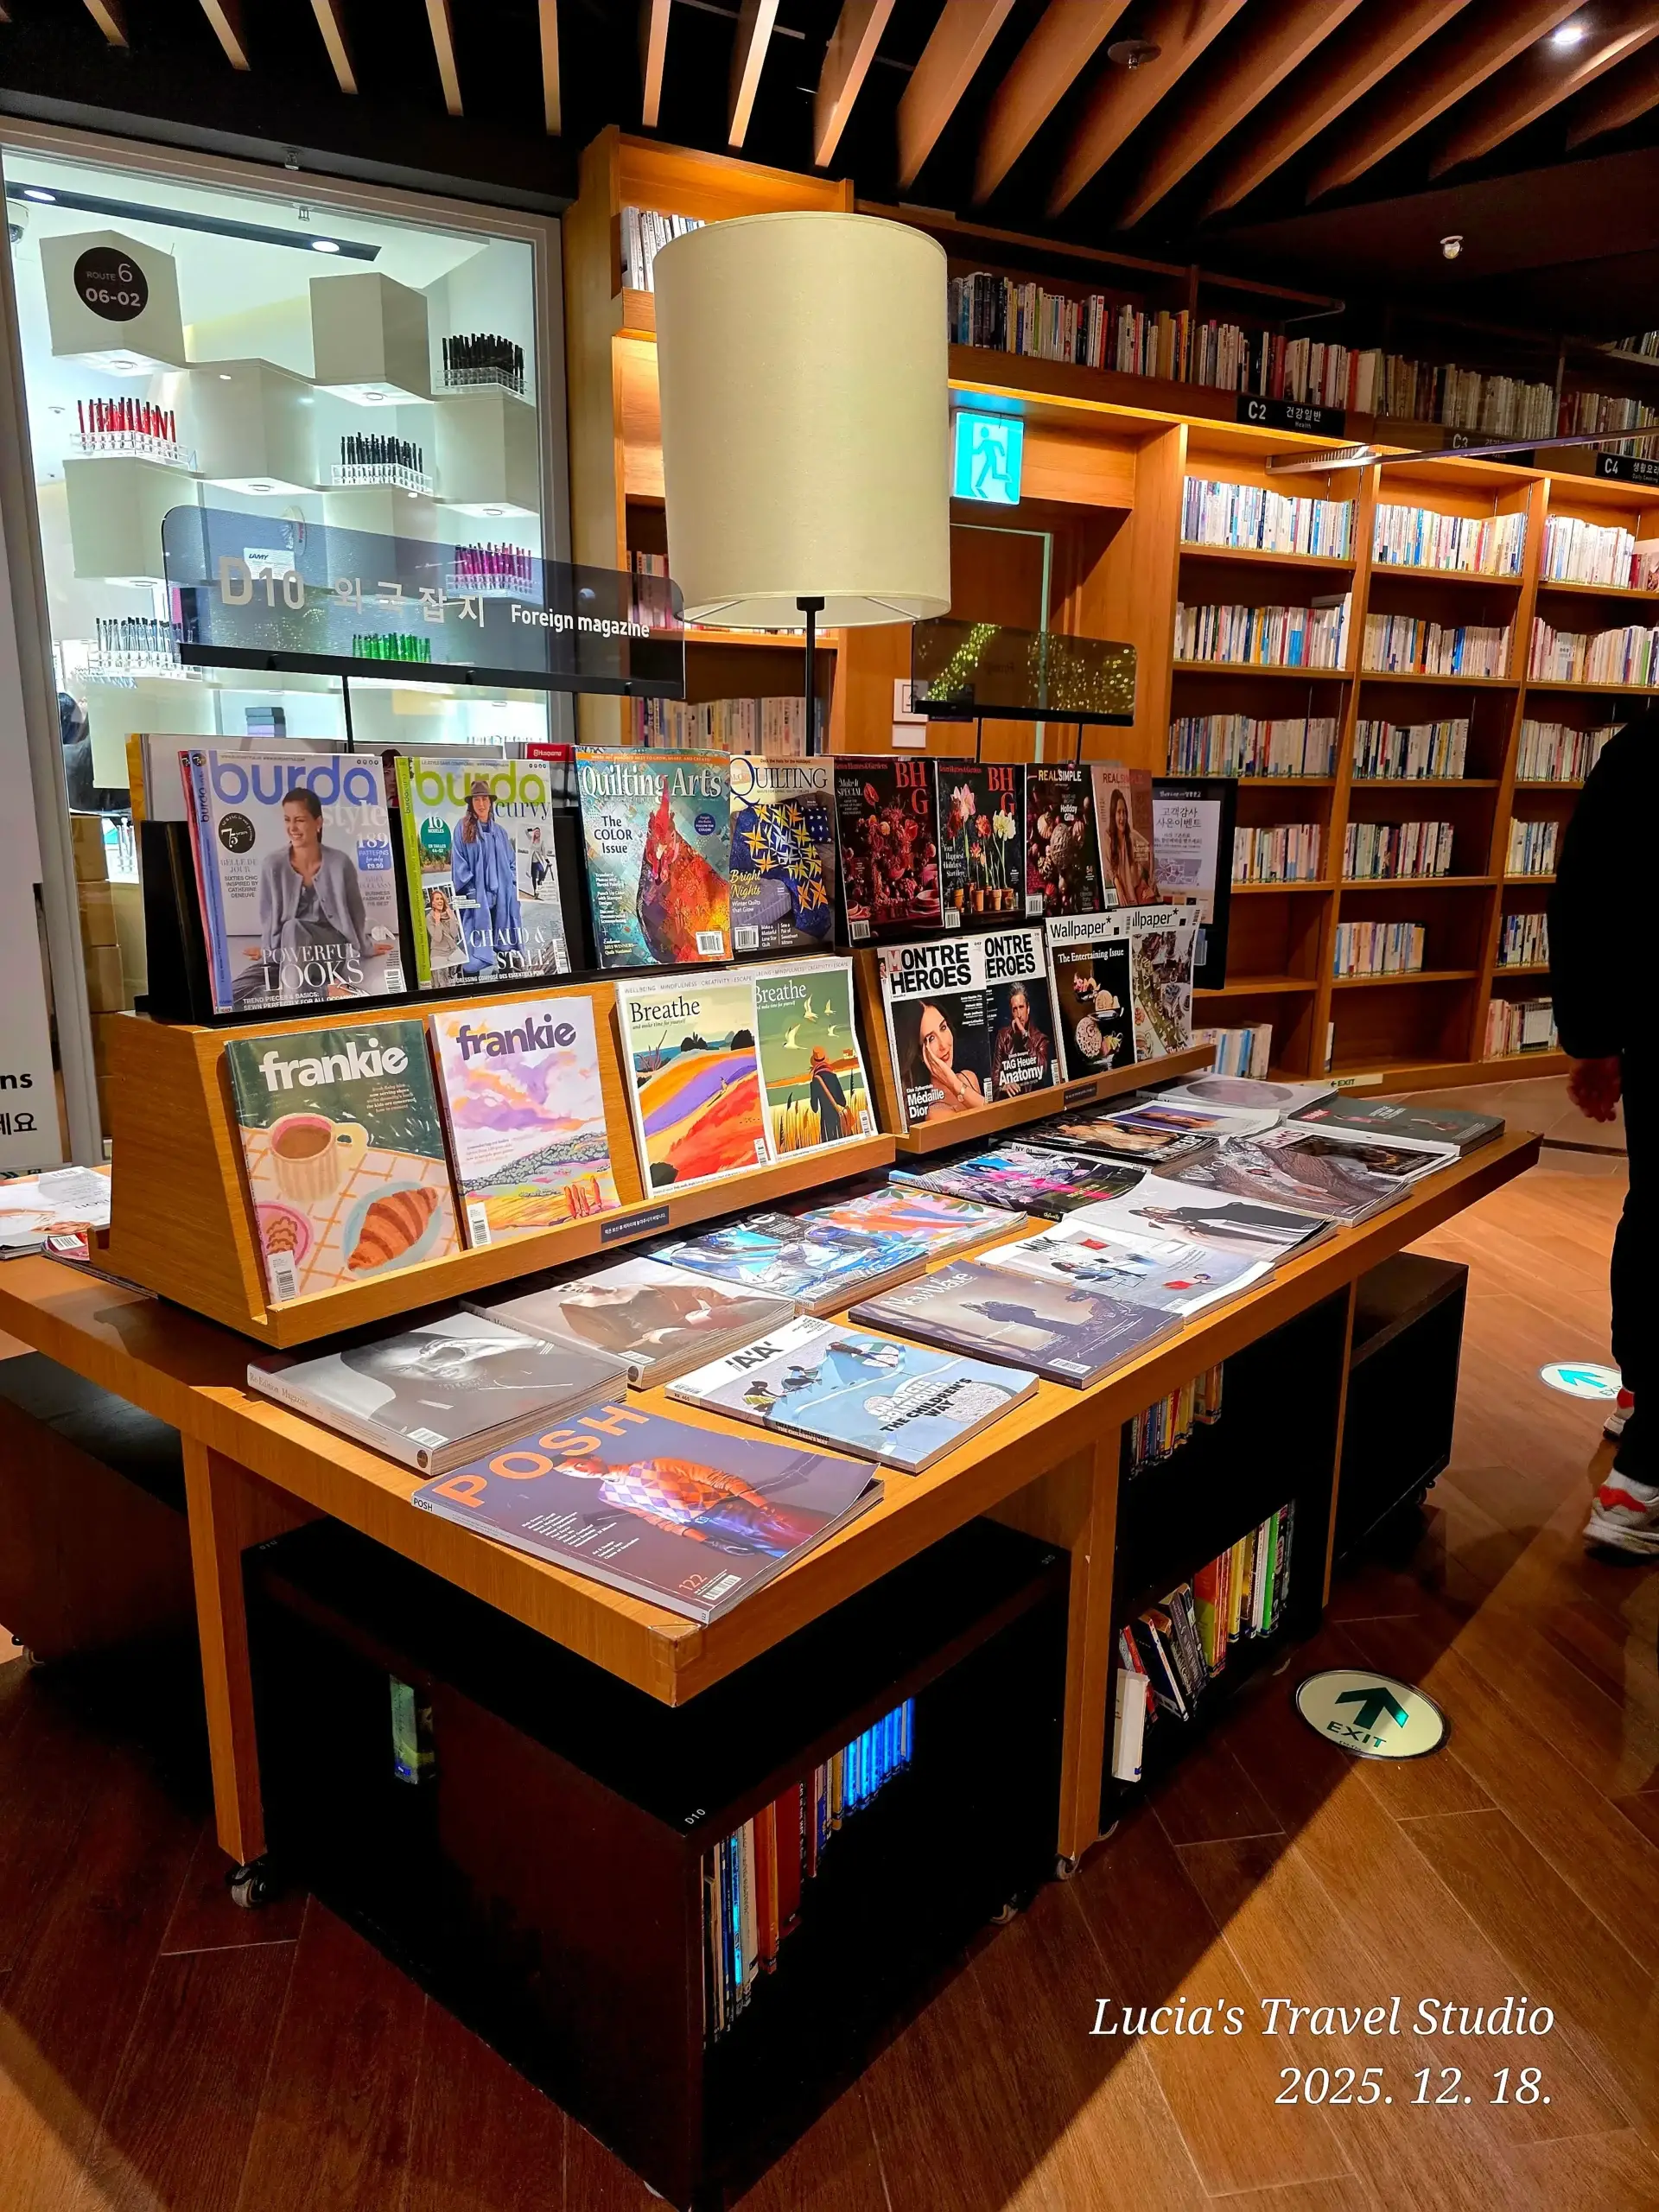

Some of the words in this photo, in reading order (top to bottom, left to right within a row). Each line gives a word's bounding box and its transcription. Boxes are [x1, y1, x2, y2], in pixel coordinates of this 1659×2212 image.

[86, 270, 116, 281] ROUTE
[118, 263, 132, 283] 6
[86, 288, 141, 307] 06-02
[1249, 401, 1266, 420] C2
[1287, 406, 1321, 423] 건강일반
[1294, 421, 1312, 429] Health
[1452, 433, 1468, 448] C3
[1605, 458, 1618, 474] C4
[219, 556, 304, 610] D10
[334, 577, 484, 627] 외국잡지
[511, 604, 575, 632] Foreign
[577, 617, 651, 639] magazine
[209, 750, 378, 805] burda
[413, 757, 546, 806] burda
[582, 765, 668, 804] Quilting
[671, 767, 721, 797] Arts
[894, 761, 927, 788] BH
[988, 767, 1014, 791] BH
[1038, 770, 1058, 782] REAL
[1058, 768, 1082, 782] SIMPLE
[1103, 772, 1120, 784] REAL
[200, 786, 210, 823] burda
[495, 801, 551, 821] curvy
[912, 788, 929, 815] G
[1001, 792, 1015, 816] G
[1060, 804, 1078, 813] Holiday
[1160, 806, 1198, 817] 고객감사
[323, 799, 388, 834] style
[428, 811, 443, 829] 16
[601, 815, 622, 827] The
[357, 832, 389, 849] 189
[594, 829, 633, 841] COLOR
[601, 842, 628, 854] Issue
[729, 869, 761, 885] Bright
[730, 884, 761, 900] Nights
[469, 927, 530, 948] CHAUD
[535, 925, 546, 944] &
[262, 943, 360, 964] POWERFUL
[888, 943, 969, 972] MONTRE
[1058, 953, 1071, 963] The
[1071, 950, 1109, 963] Entertaining
[1109, 949, 1124, 958] Issue
[261, 958, 364, 992] LOOKS
[985, 953, 1036, 980] EROES
[625, 985, 657, 994] WELLBEING
[660, 981, 697, 990] MINDFULNESS
[701, 977, 730, 986] CREATIVITY
[890, 963, 972, 995] HEROES
[755, 979, 807, 1004] Breathe
[263, 1001, 299, 1009] PERFECTLY
[629, 995, 702, 1024] Breathe
[670, 1018, 686, 1027] yourself
[456, 1014, 576, 1061] frankie
[259, 1038, 409, 1092] frankie
[1001, 1060, 1016, 1071] TAG
[1016, 1056, 1037, 1068] Heuer
[999, 1065, 1044, 1086] Anatomy
[907, 1090, 945, 1107] Médaille
[909, 1104, 929, 1119] Dior
[282, 1387, 309, 1408] Magazine
[879, 1417, 911, 1432] THE
[906, 1377, 972, 1418] CHILDREN'S
[924, 1400, 955, 1417] WAY
[432, 1406, 650, 1509] POSH
[414, 1497, 433, 1512] POSH
[679, 1574, 708, 1591] 122
[1326, 1720, 1387, 1749] EXIT
[684, 1808, 706, 1824] D10
